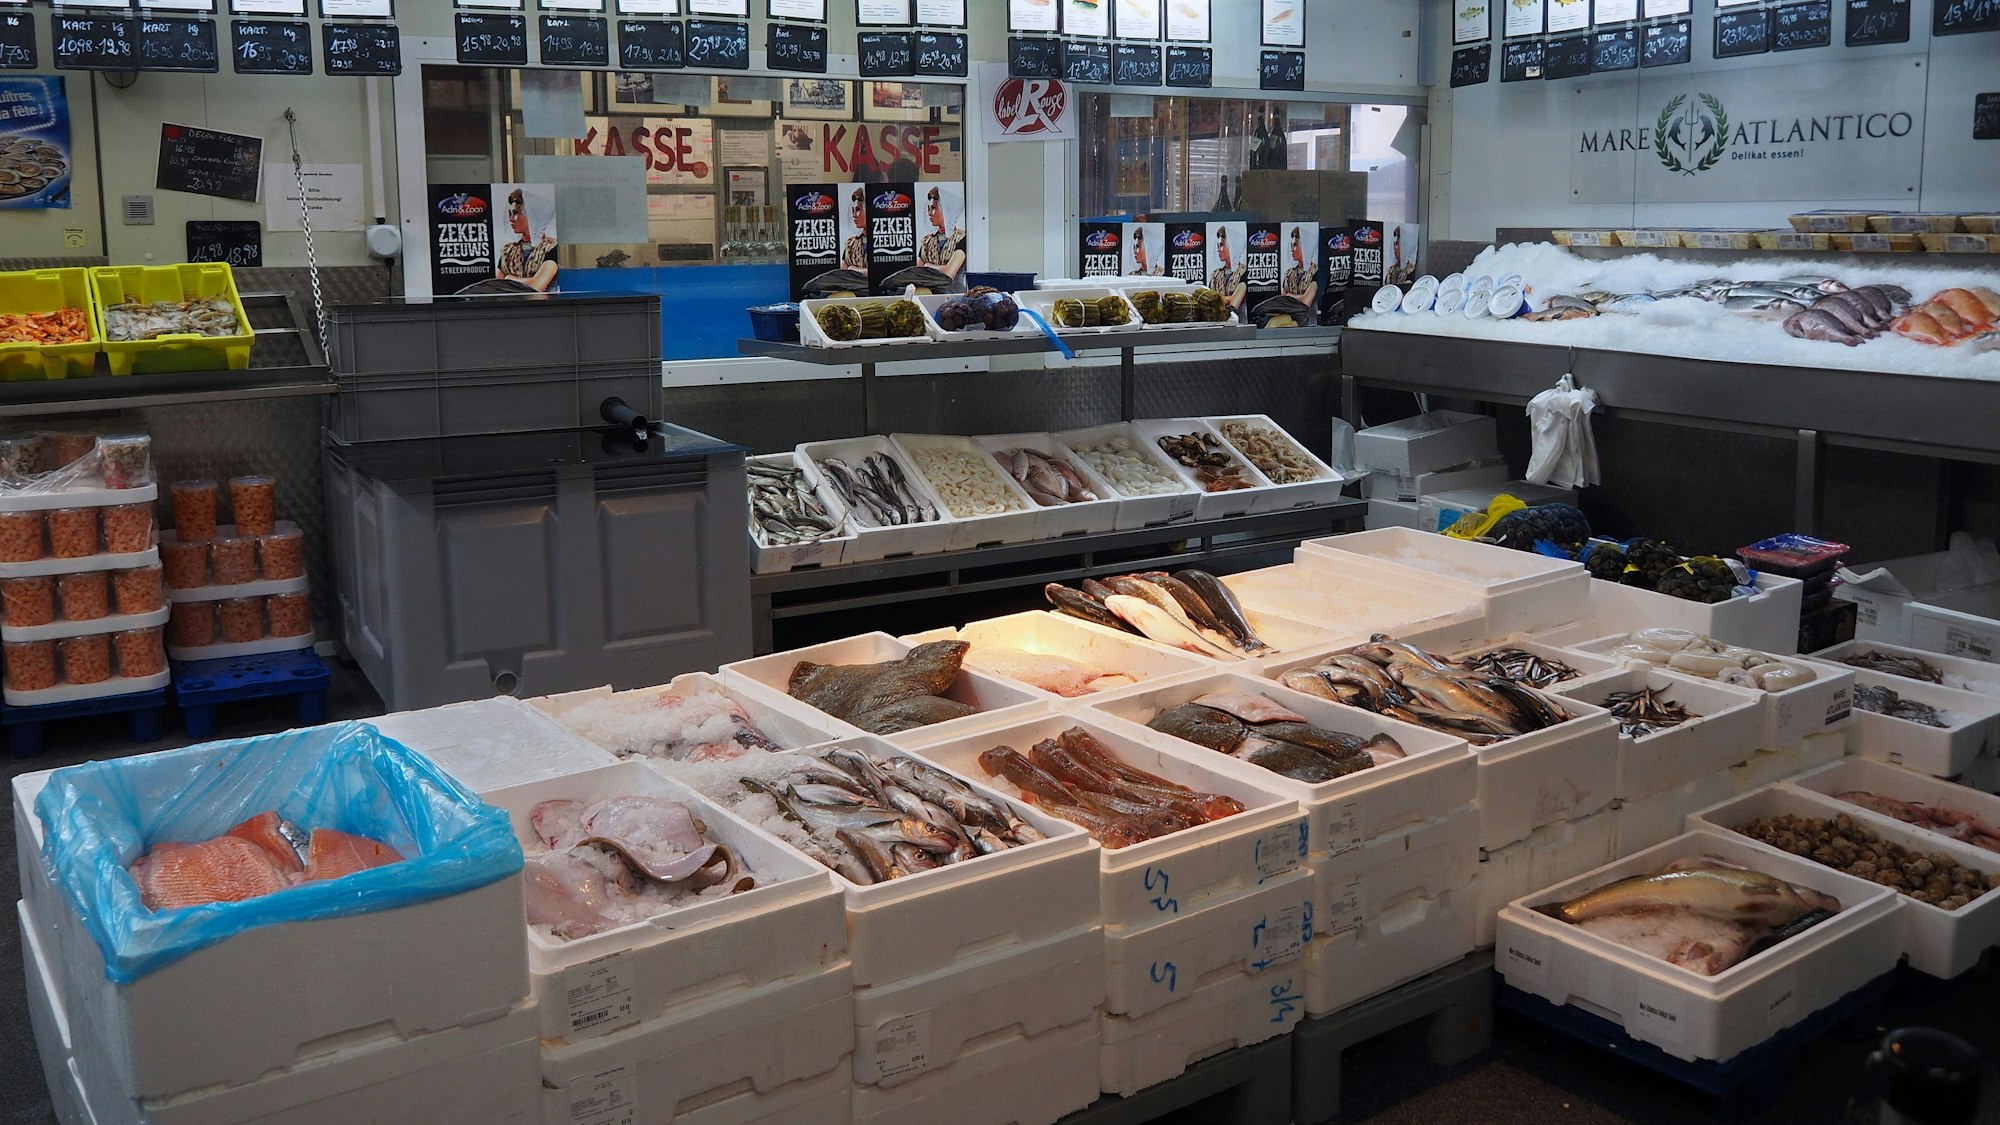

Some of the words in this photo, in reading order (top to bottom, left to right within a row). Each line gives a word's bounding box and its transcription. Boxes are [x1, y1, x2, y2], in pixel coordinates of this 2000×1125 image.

[62, 19, 94, 31] KART
[142, 22, 172, 33] KART
[12, 105, 37, 118] fête
[1580, 127, 1650, 153] MARE
[1731, 112, 1913, 146] ATLANTICO
[823, 123, 940, 174] KASSE
[1731, 150, 1767, 160] Delikat
[1771, 149, 1804, 159] essen!
[438, 222, 489, 243] ZEKER
[795, 219, 836, 237] ZEKER
[873, 217, 913, 235] ZEKER
[795, 235, 837, 250] ZEEUWS
[873, 233, 913, 248] ZEEUWS
[439, 242, 490, 258] ZEEUWS
[1353, 248, 1381, 263] ZEKER
[796, 257, 837, 266] STREEKPRODUCT
[873, 254, 913, 263] STREEKPRODUCT
[1085, 254, 1118, 270] ZEKER
[1172, 254, 1203, 269] ZEKER
[1247, 253, 1278, 268] ZEKER
[1328, 255, 1351, 271] ZEKE
[440, 266, 490, 275] STREEKPRODUCT
[1172, 268, 1203, 281] ZEEUWS
[1247, 267, 1278, 279] ZEEUWS
[1354, 261, 1381, 274] ZEEUWS
